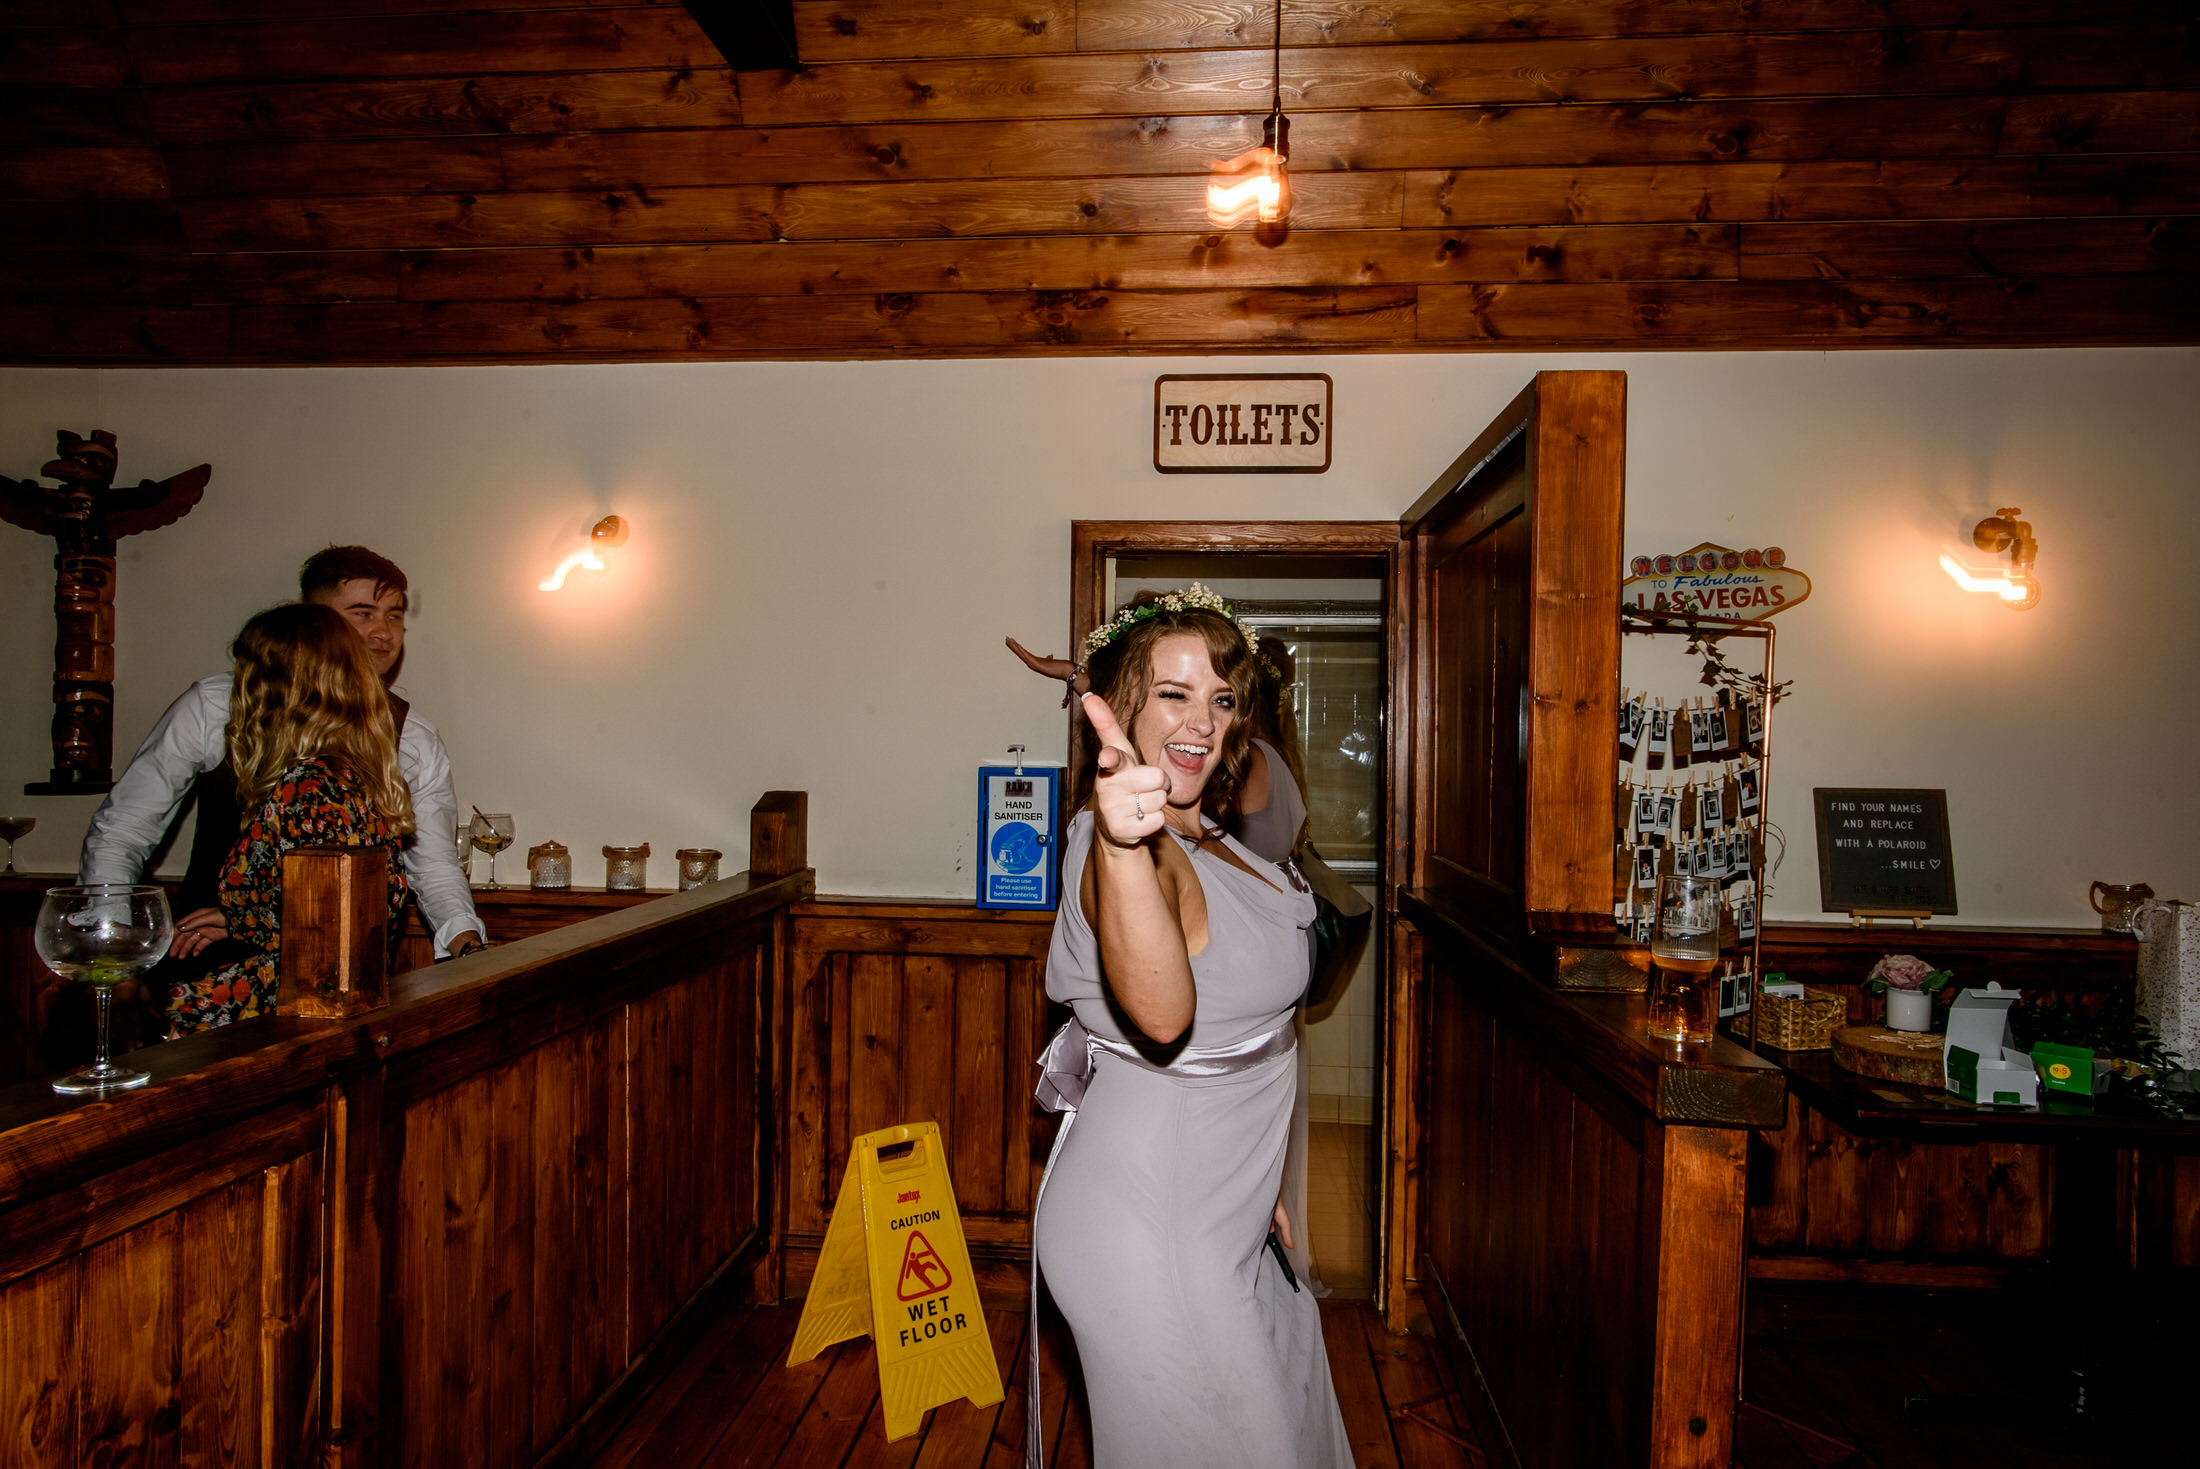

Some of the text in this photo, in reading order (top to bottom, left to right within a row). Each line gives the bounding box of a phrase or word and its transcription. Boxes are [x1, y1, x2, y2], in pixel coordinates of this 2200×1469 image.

[1165, 403, 1320, 445] TOILETS
[1634, 551, 1781, 575] WELCOME
[1651, 573, 1765, 590] TO Fabulous
[1637, 585, 1785, 612] LAS VEGAS
[1005, 781, 1033, 792] RANCH
[1005, 801, 1033, 809] HAND
[1831, 802, 1922, 813] FIND YOUR NAMES
[994, 812, 1043, 821] SANITISER
[1843, 820, 1914, 830] AND REPLACE
[1835, 839, 1926, 850] WITH A POLAROID
[897, 1190, 921, 1204] Jantex
[890, 1209, 941, 1231] CAUTION
[908, 1295, 950, 1322] WET
[900, 1313, 967, 1347] FLOOR
